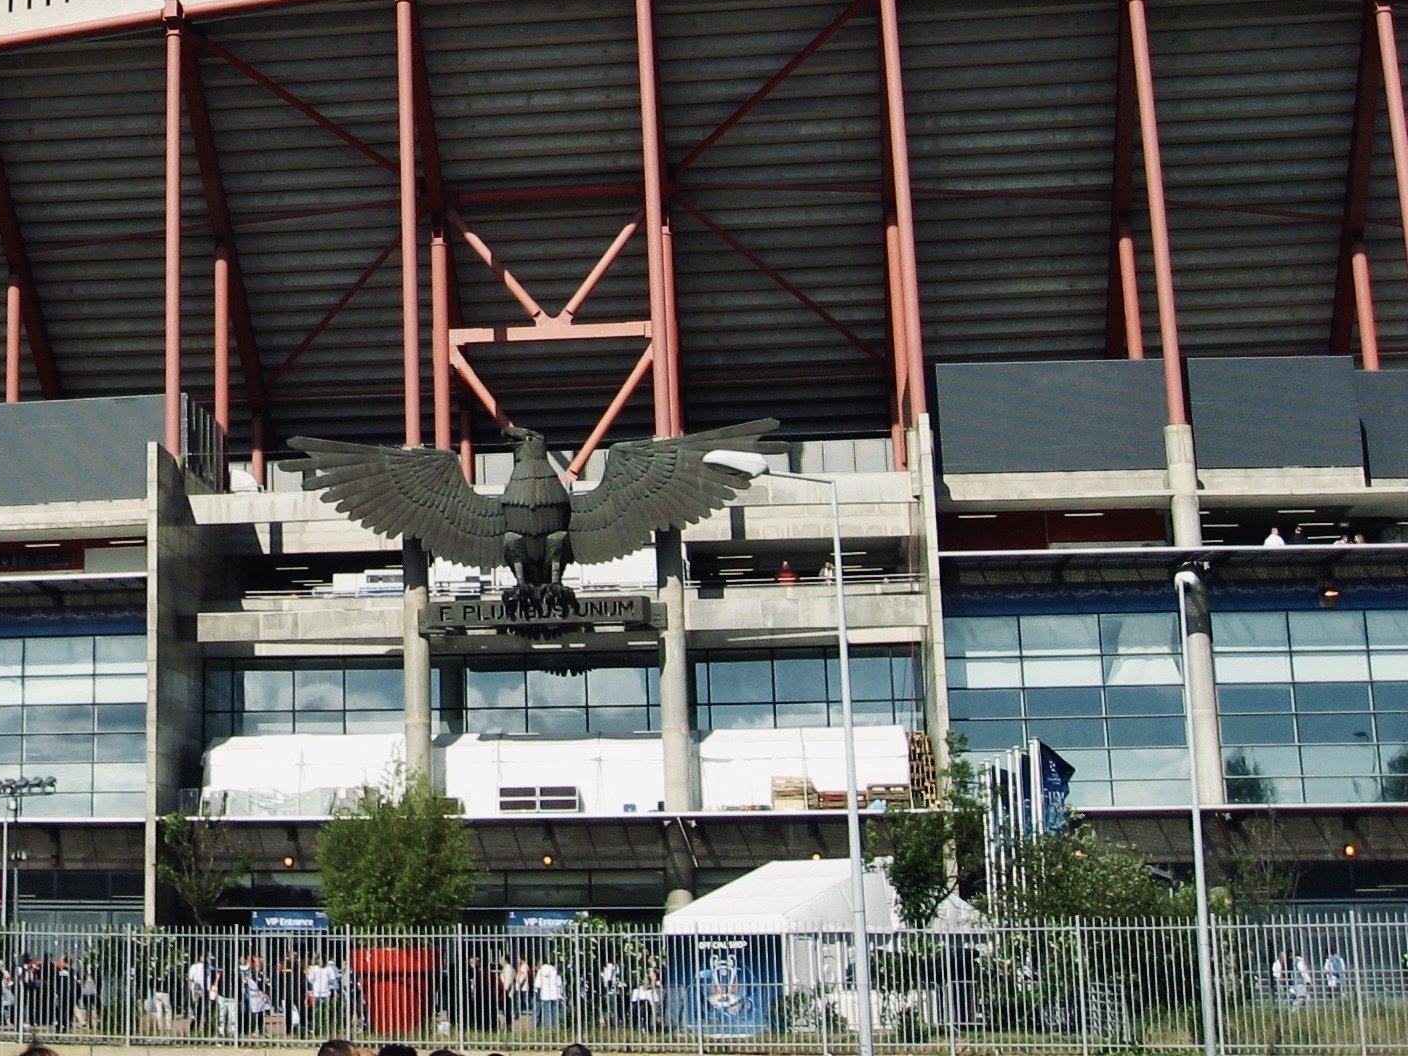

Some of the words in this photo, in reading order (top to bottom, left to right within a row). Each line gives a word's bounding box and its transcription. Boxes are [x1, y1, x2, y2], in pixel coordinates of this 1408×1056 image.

[439, 605, 452, 622] E
[577, 600, 634, 618] UNUM
[265, 917, 279, 926] VIP
